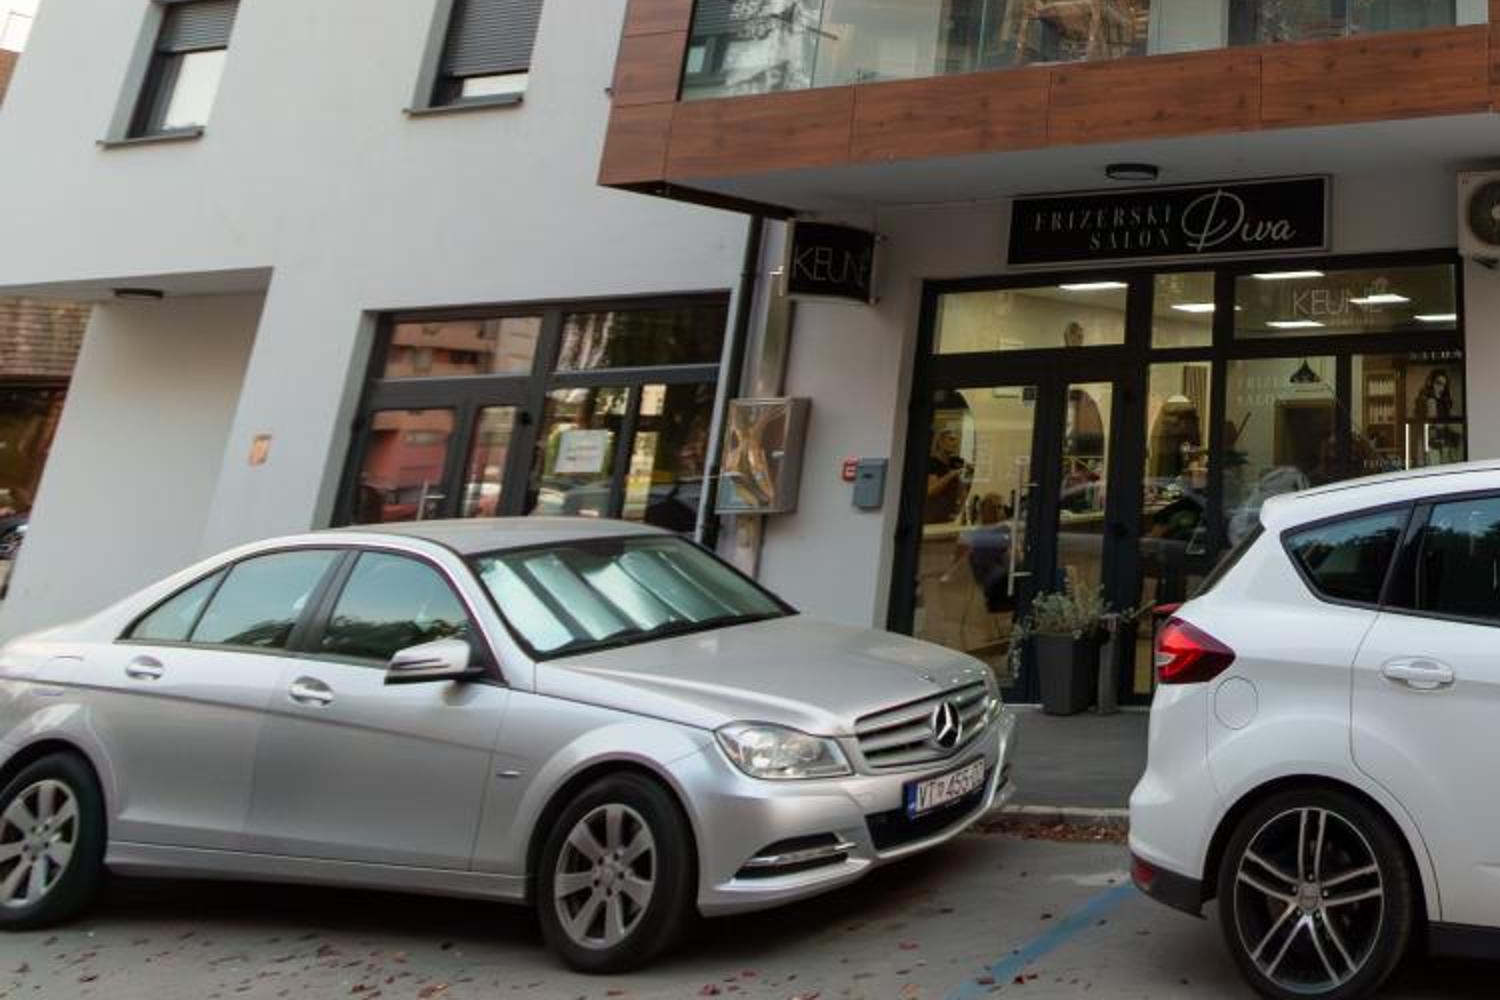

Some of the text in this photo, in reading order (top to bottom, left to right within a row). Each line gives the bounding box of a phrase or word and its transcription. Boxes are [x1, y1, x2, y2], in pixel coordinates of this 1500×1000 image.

[1034, 203, 1172, 233] FRIZERSKI
[1181, 187, 1297, 252] Diva
[1089, 228, 1171, 250] SALON
